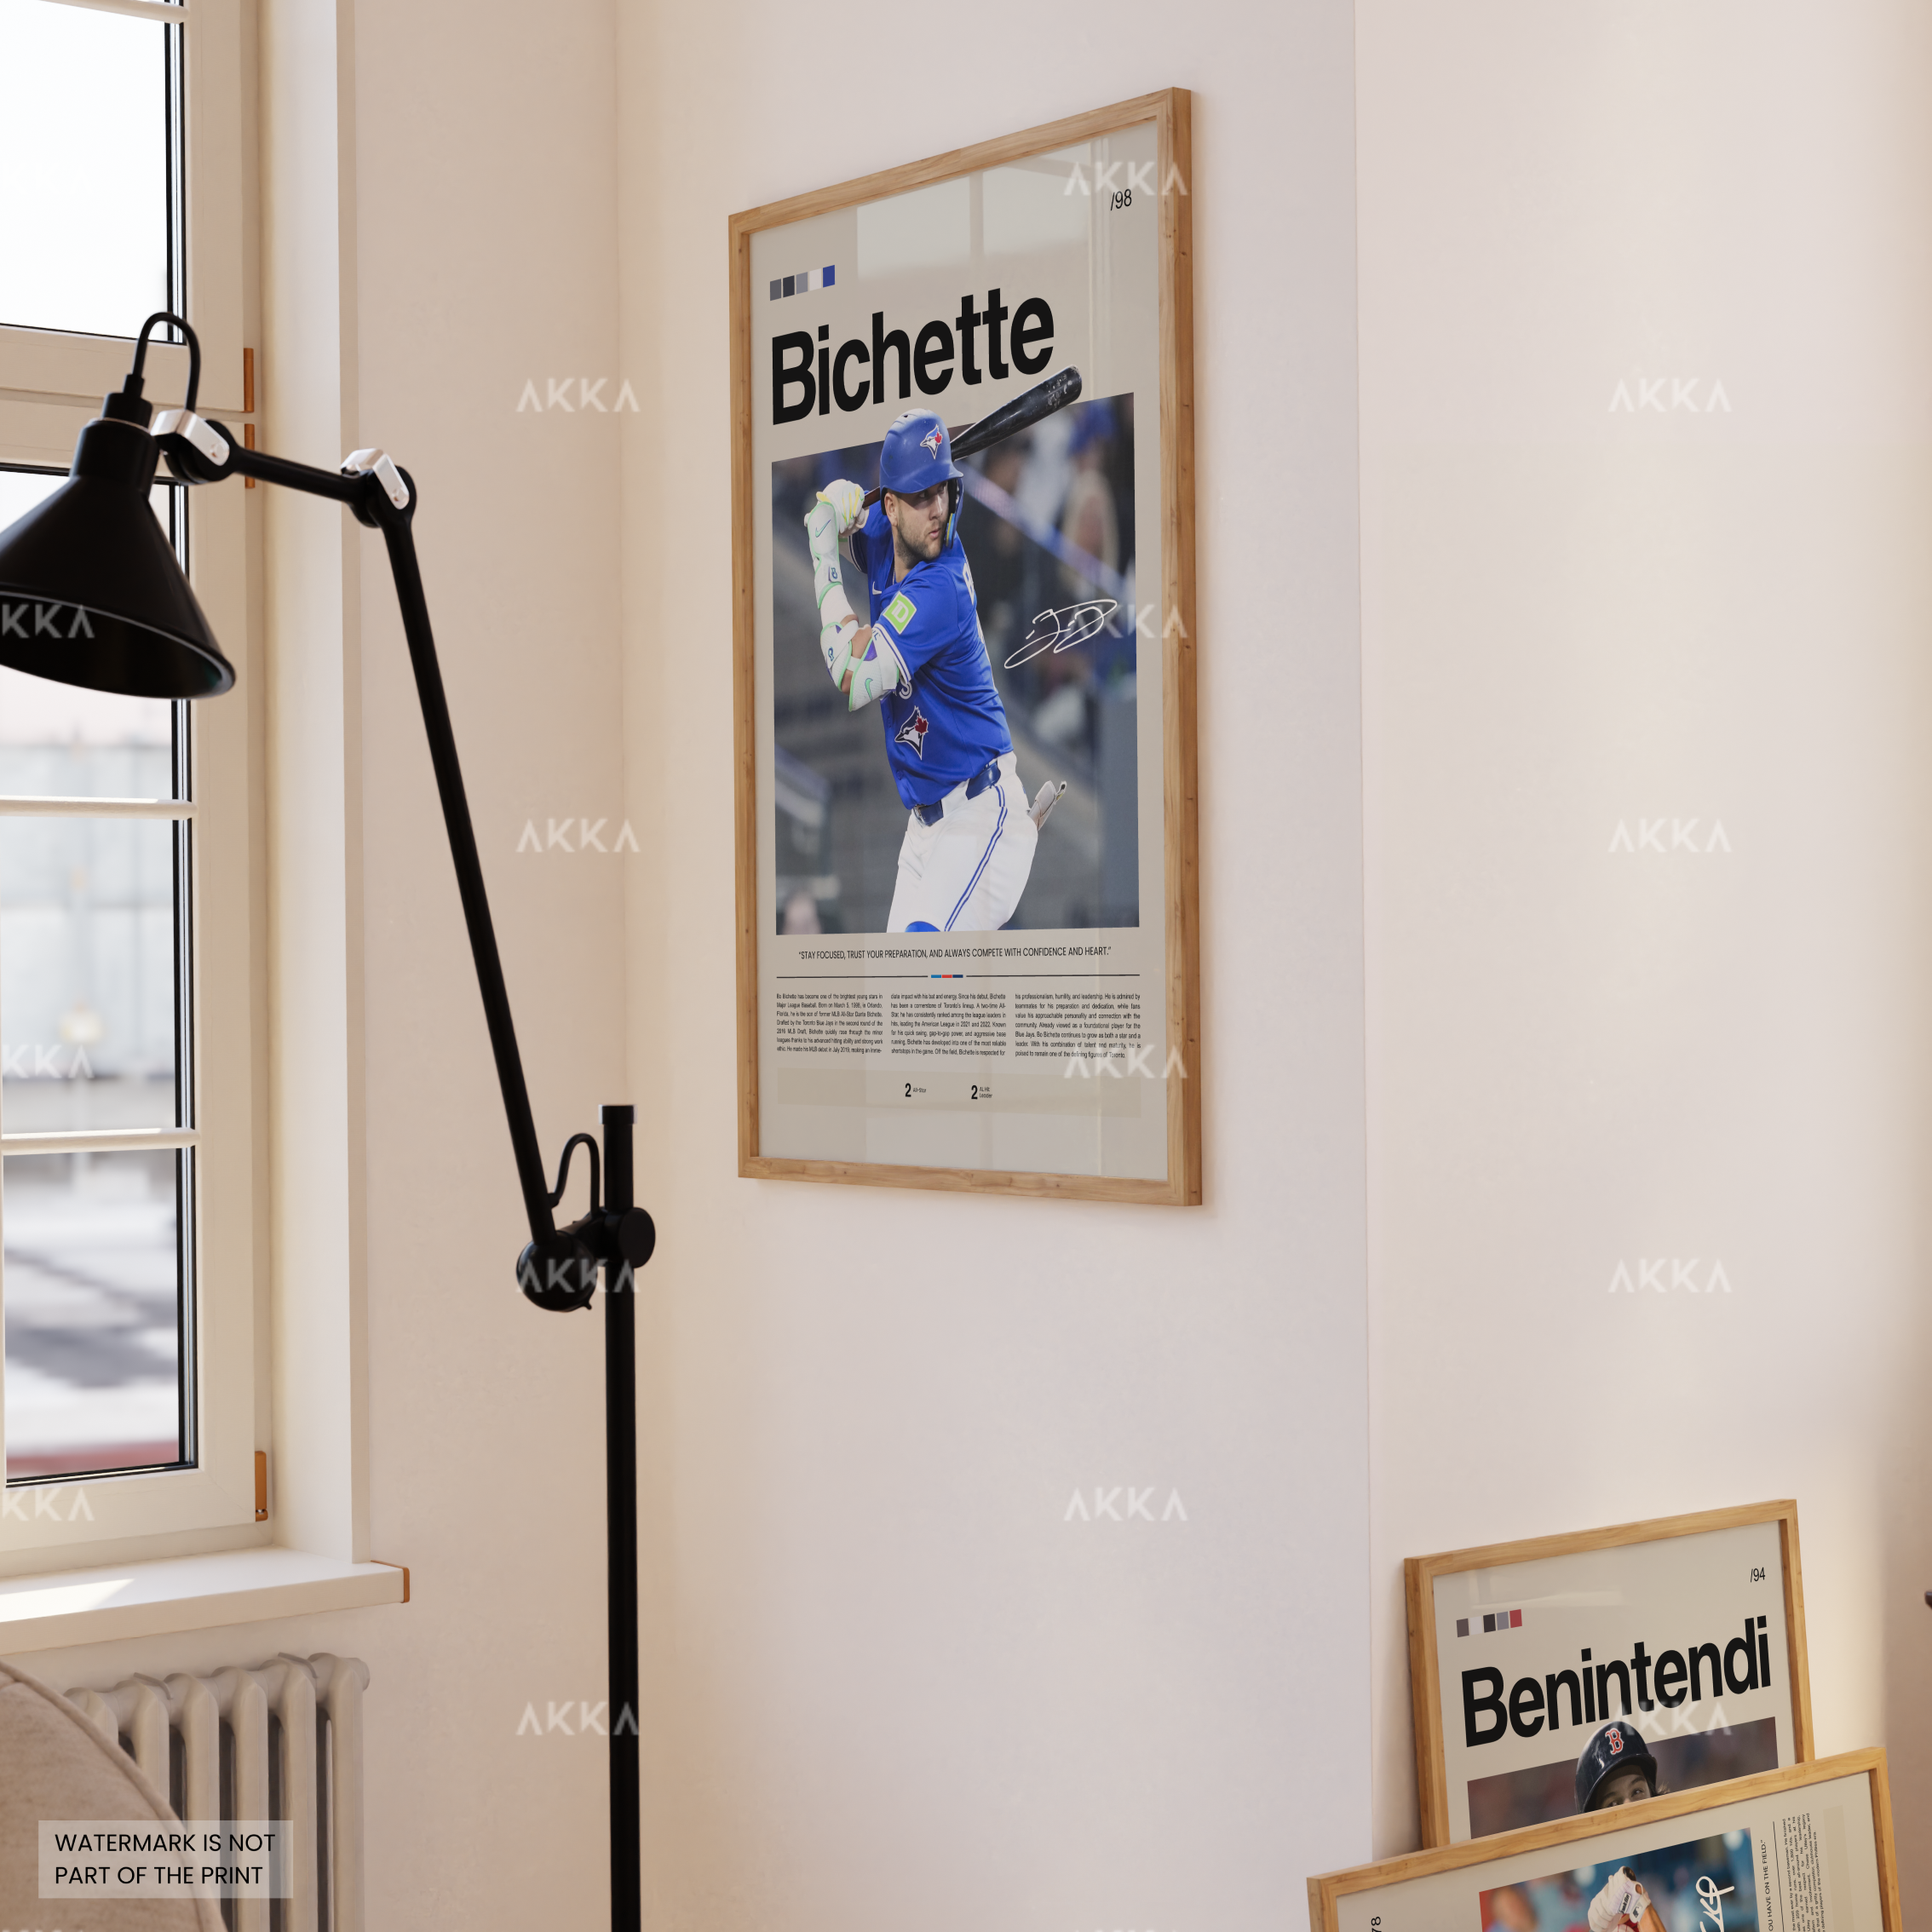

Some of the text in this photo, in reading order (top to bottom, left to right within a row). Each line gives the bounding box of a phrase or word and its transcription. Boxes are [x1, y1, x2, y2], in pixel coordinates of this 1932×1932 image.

[1110, 189, 1132, 211] /98
[772, 288, 1054, 425] Bichette
[817, 951, 845, 960] FOCUSED,
[847, 950, 865, 958] TRUST
[867, 950, 884, 958] YOUR
[885, 950, 927, 959] PREPARATION,
[929, 949, 943, 957] AND
[945, 949, 971, 957] ALWAYS
[972, 948, 1003, 957] COMPETE
[1004, 948, 1021, 956] WITH
[1023, 947, 1066, 956] CONFIDENCE
[1068, 947, 1083, 955] AND
[905, 1083, 911, 1097] 2
[971, 1085, 978, 1099] 2
[1750, 1567, 1765, 1583] /94
[1461, 1615, 1771, 1748] Benintendi
[1605, 1728, 1624, 1755] B
[1765, 1882, 1770, 1894] ON
